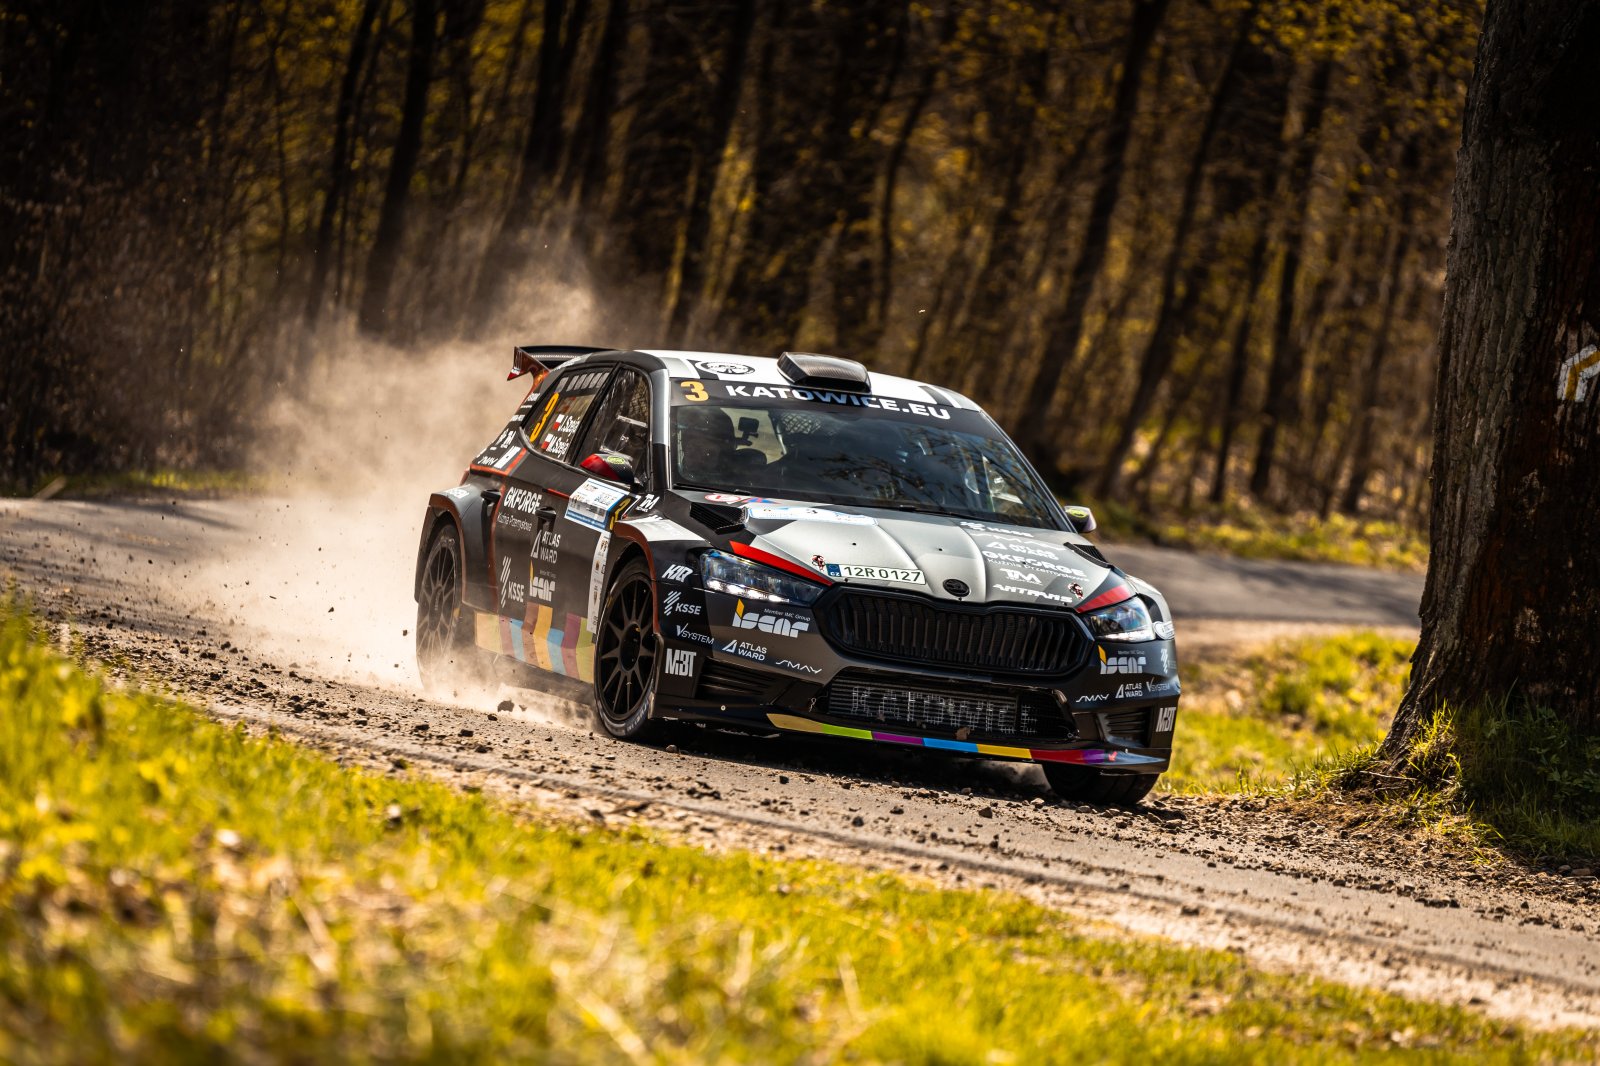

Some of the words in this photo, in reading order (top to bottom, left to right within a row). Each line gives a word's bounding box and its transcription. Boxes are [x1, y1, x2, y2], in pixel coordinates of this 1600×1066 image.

[680, 381, 709, 402] 3
[725, 385, 951, 420] KATOWICE.EU
[529, 392, 559, 442] 3
[503, 486, 543, 515] GKFORGE
[541, 531, 562, 548] ATLAS
[540, 546, 558, 564] WARD
[843, 566, 876, 578] 12R
[879, 569, 921, 582] 0127
[508, 580, 525, 603] KSSE
[675, 602, 702, 616] KSSE
[737, 648, 766, 662] WARD
[739, 641, 768, 655] ATLAS
[1124, 690, 1144, 698] WARD
[1125, 683, 1143, 691] ATLAS
